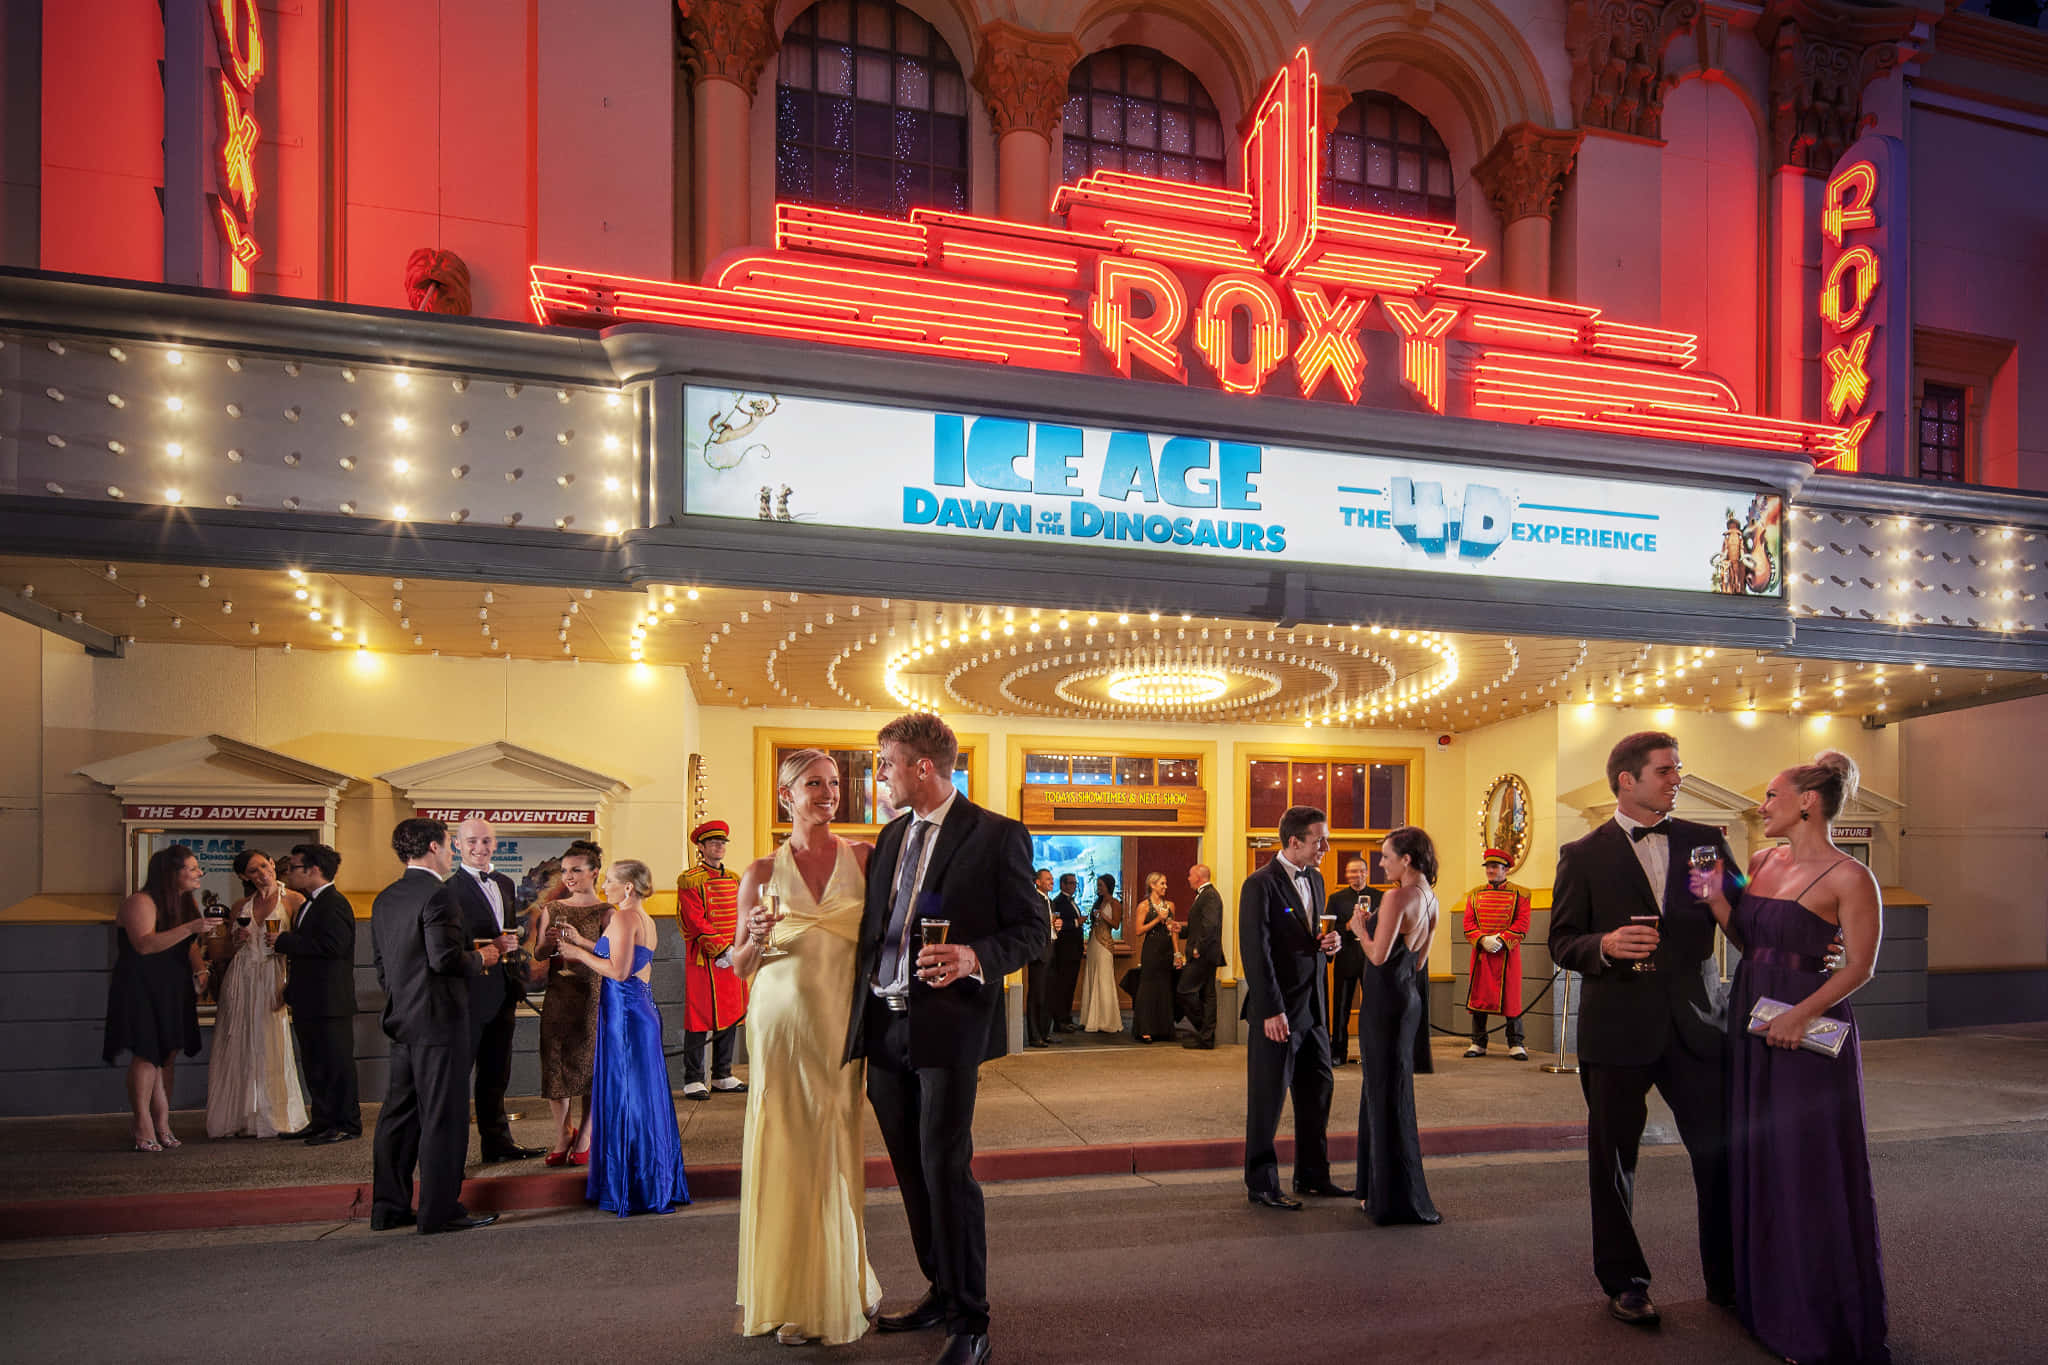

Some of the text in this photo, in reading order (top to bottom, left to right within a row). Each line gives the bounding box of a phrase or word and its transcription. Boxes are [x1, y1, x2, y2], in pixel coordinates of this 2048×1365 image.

[213, 0, 264, 293] OXY
[1088, 254, 1465, 415] ROXY
[1820, 160, 1880, 472] ROXY
[934, 413, 1262, 510] ICE AGE
[903, 486, 1287, 553] DAWN OF THE DINOSAURS
[1339, 506, 1391, 529] THE
[1512, 522, 1657, 552] EXPERIENCE
[138, 806, 318, 819] THE 4D ADVENTURE
[426, 810, 589, 822] THE 4D ADVENTURE
[1078, 791, 1126, 804] SHOWTIMES
[1139, 793, 1160, 805] NEXT
[1163, 794, 1187, 805] SHOW
[1832, 828, 1868, 837] ENTURE
